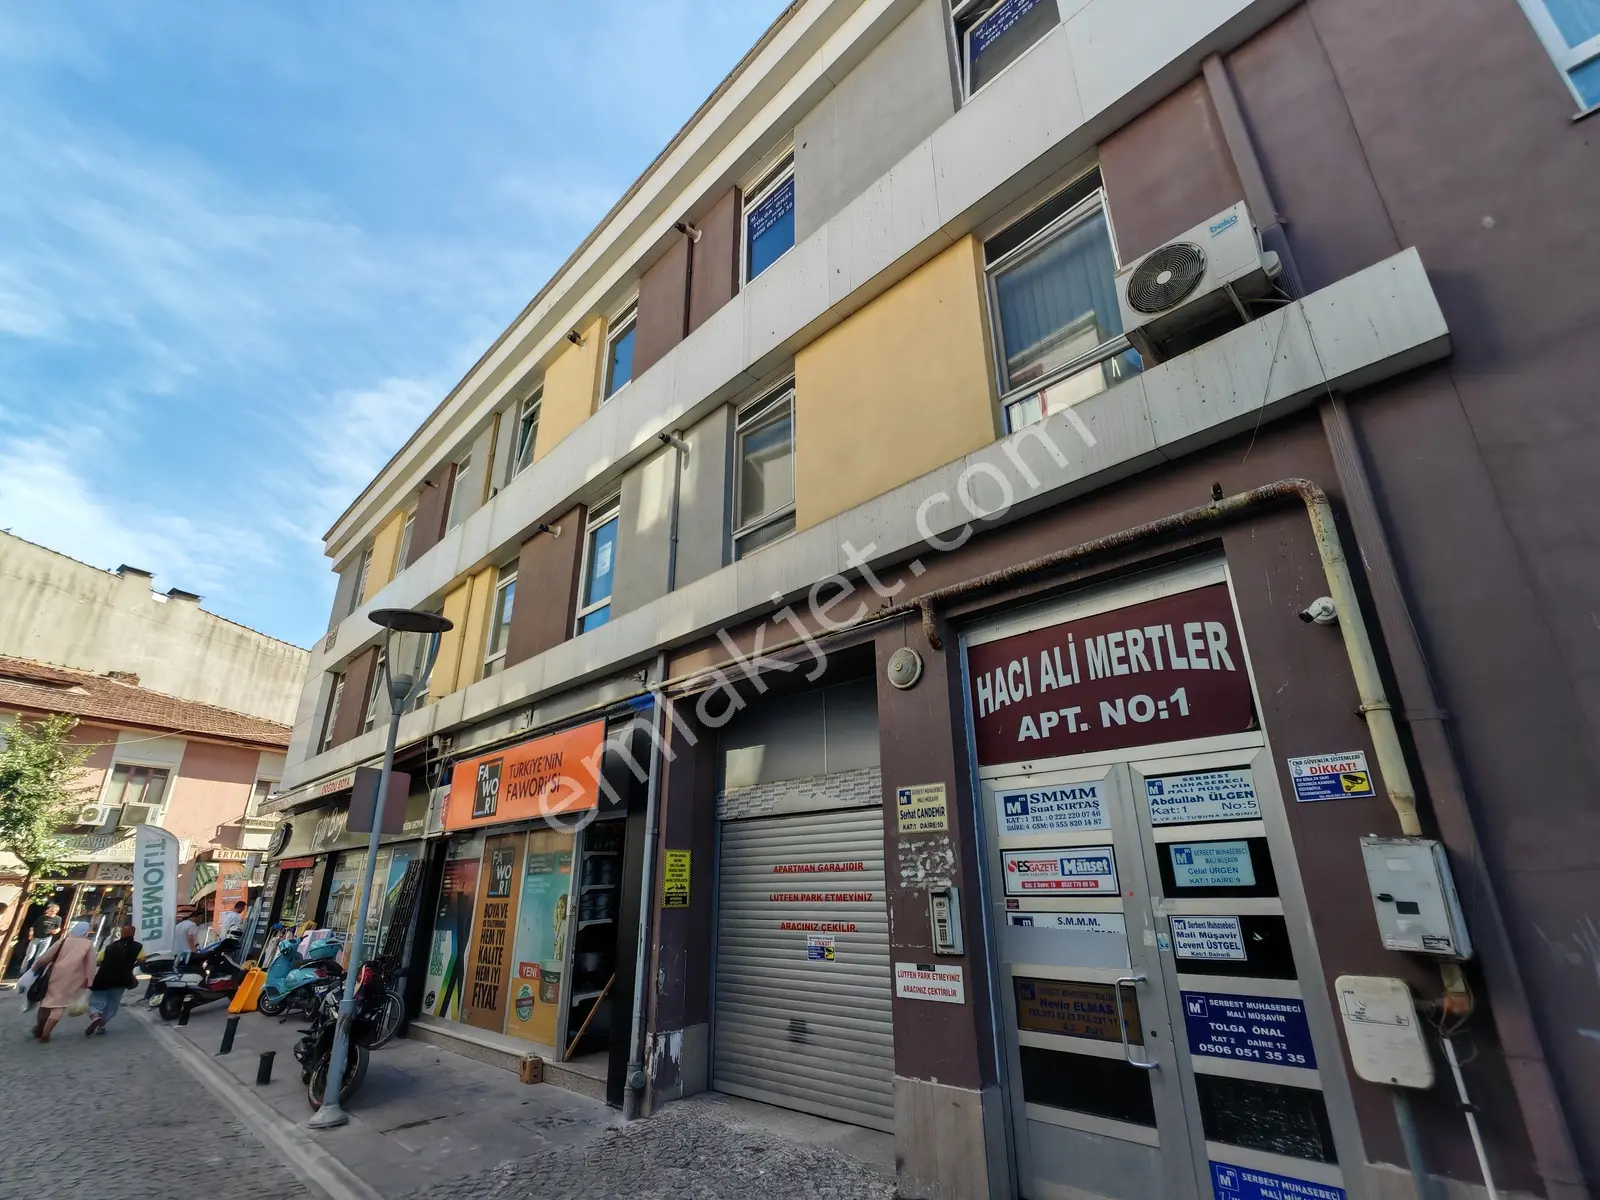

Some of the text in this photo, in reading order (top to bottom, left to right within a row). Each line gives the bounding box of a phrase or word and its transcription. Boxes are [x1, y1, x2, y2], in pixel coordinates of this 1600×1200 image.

[1210, 215, 1237, 232] beko
[976, 621, 1236, 718] HACI ALİ MERTLER
[1018, 687, 1190, 741] APT. NO:1
[478, 764, 489, 781] FA
[1309, 762, 1358, 775] DİKKAT!
[482, 778, 499, 797] WO
[1172, 777, 1244, 788] MUHASEBECİ
[1198, 783, 1250, 791] MÜŞAVİR
[1029, 787, 1097, 804] SMMM
[1151, 791, 1254, 806] Abdullah ÜLGEN
[900, 804, 945, 820] Serhat CANDEMİR
[1030, 800, 1100, 813] Suat KIRTAŞ
[1222, 801, 1256, 810] No:5
[920, 821, 943, 829] DAİRE:10
[492, 851, 503, 865] FA
[497, 865, 512, 879] WO
[773, 862, 864, 873] APARTMAN GARAJIDIR
[825, 892, 873, 901] ETMEYİNİZ
[484, 903, 509, 919] BOYA VE
[780, 922, 859, 934] ARACINIZ ÇEKİLİR.
[1057, 917, 1100, 926] S.M.M.M.
[1188, 921, 1236, 929] Serbest Muhasebeci
[481, 929, 495, 945] HEM
[1178, 940, 1240, 950] Levent ÜSTGEL
[475, 965, 490, 982] HEM
[523, 965, 537, 977] YENİ
[898, 969, 960, 982] LÜTFEN PARK ETMEYİNİZ
[903, 985, 957, 997] ARACINIZ ÇEKTİRİLİR
[1209, 999, 1301, 1013] SERBEST MUHASEBECİ
[1226, 1011, 1286, 1023] MALİ MÜŞAVİR
[1209, 1023, 1285, 1037] TOLGA ÖNAL
[1211, 1035, 1227, 1043] KAT
[1247, 1039, 1274, 1048] DAİRE
[1276, 1042, 1287, 1050] 12
[1199, 1043, 1306, 1063] 0506 051 35 35
[1242, 1172, 1340, 1199] SERBEST MUHASEBECİ
